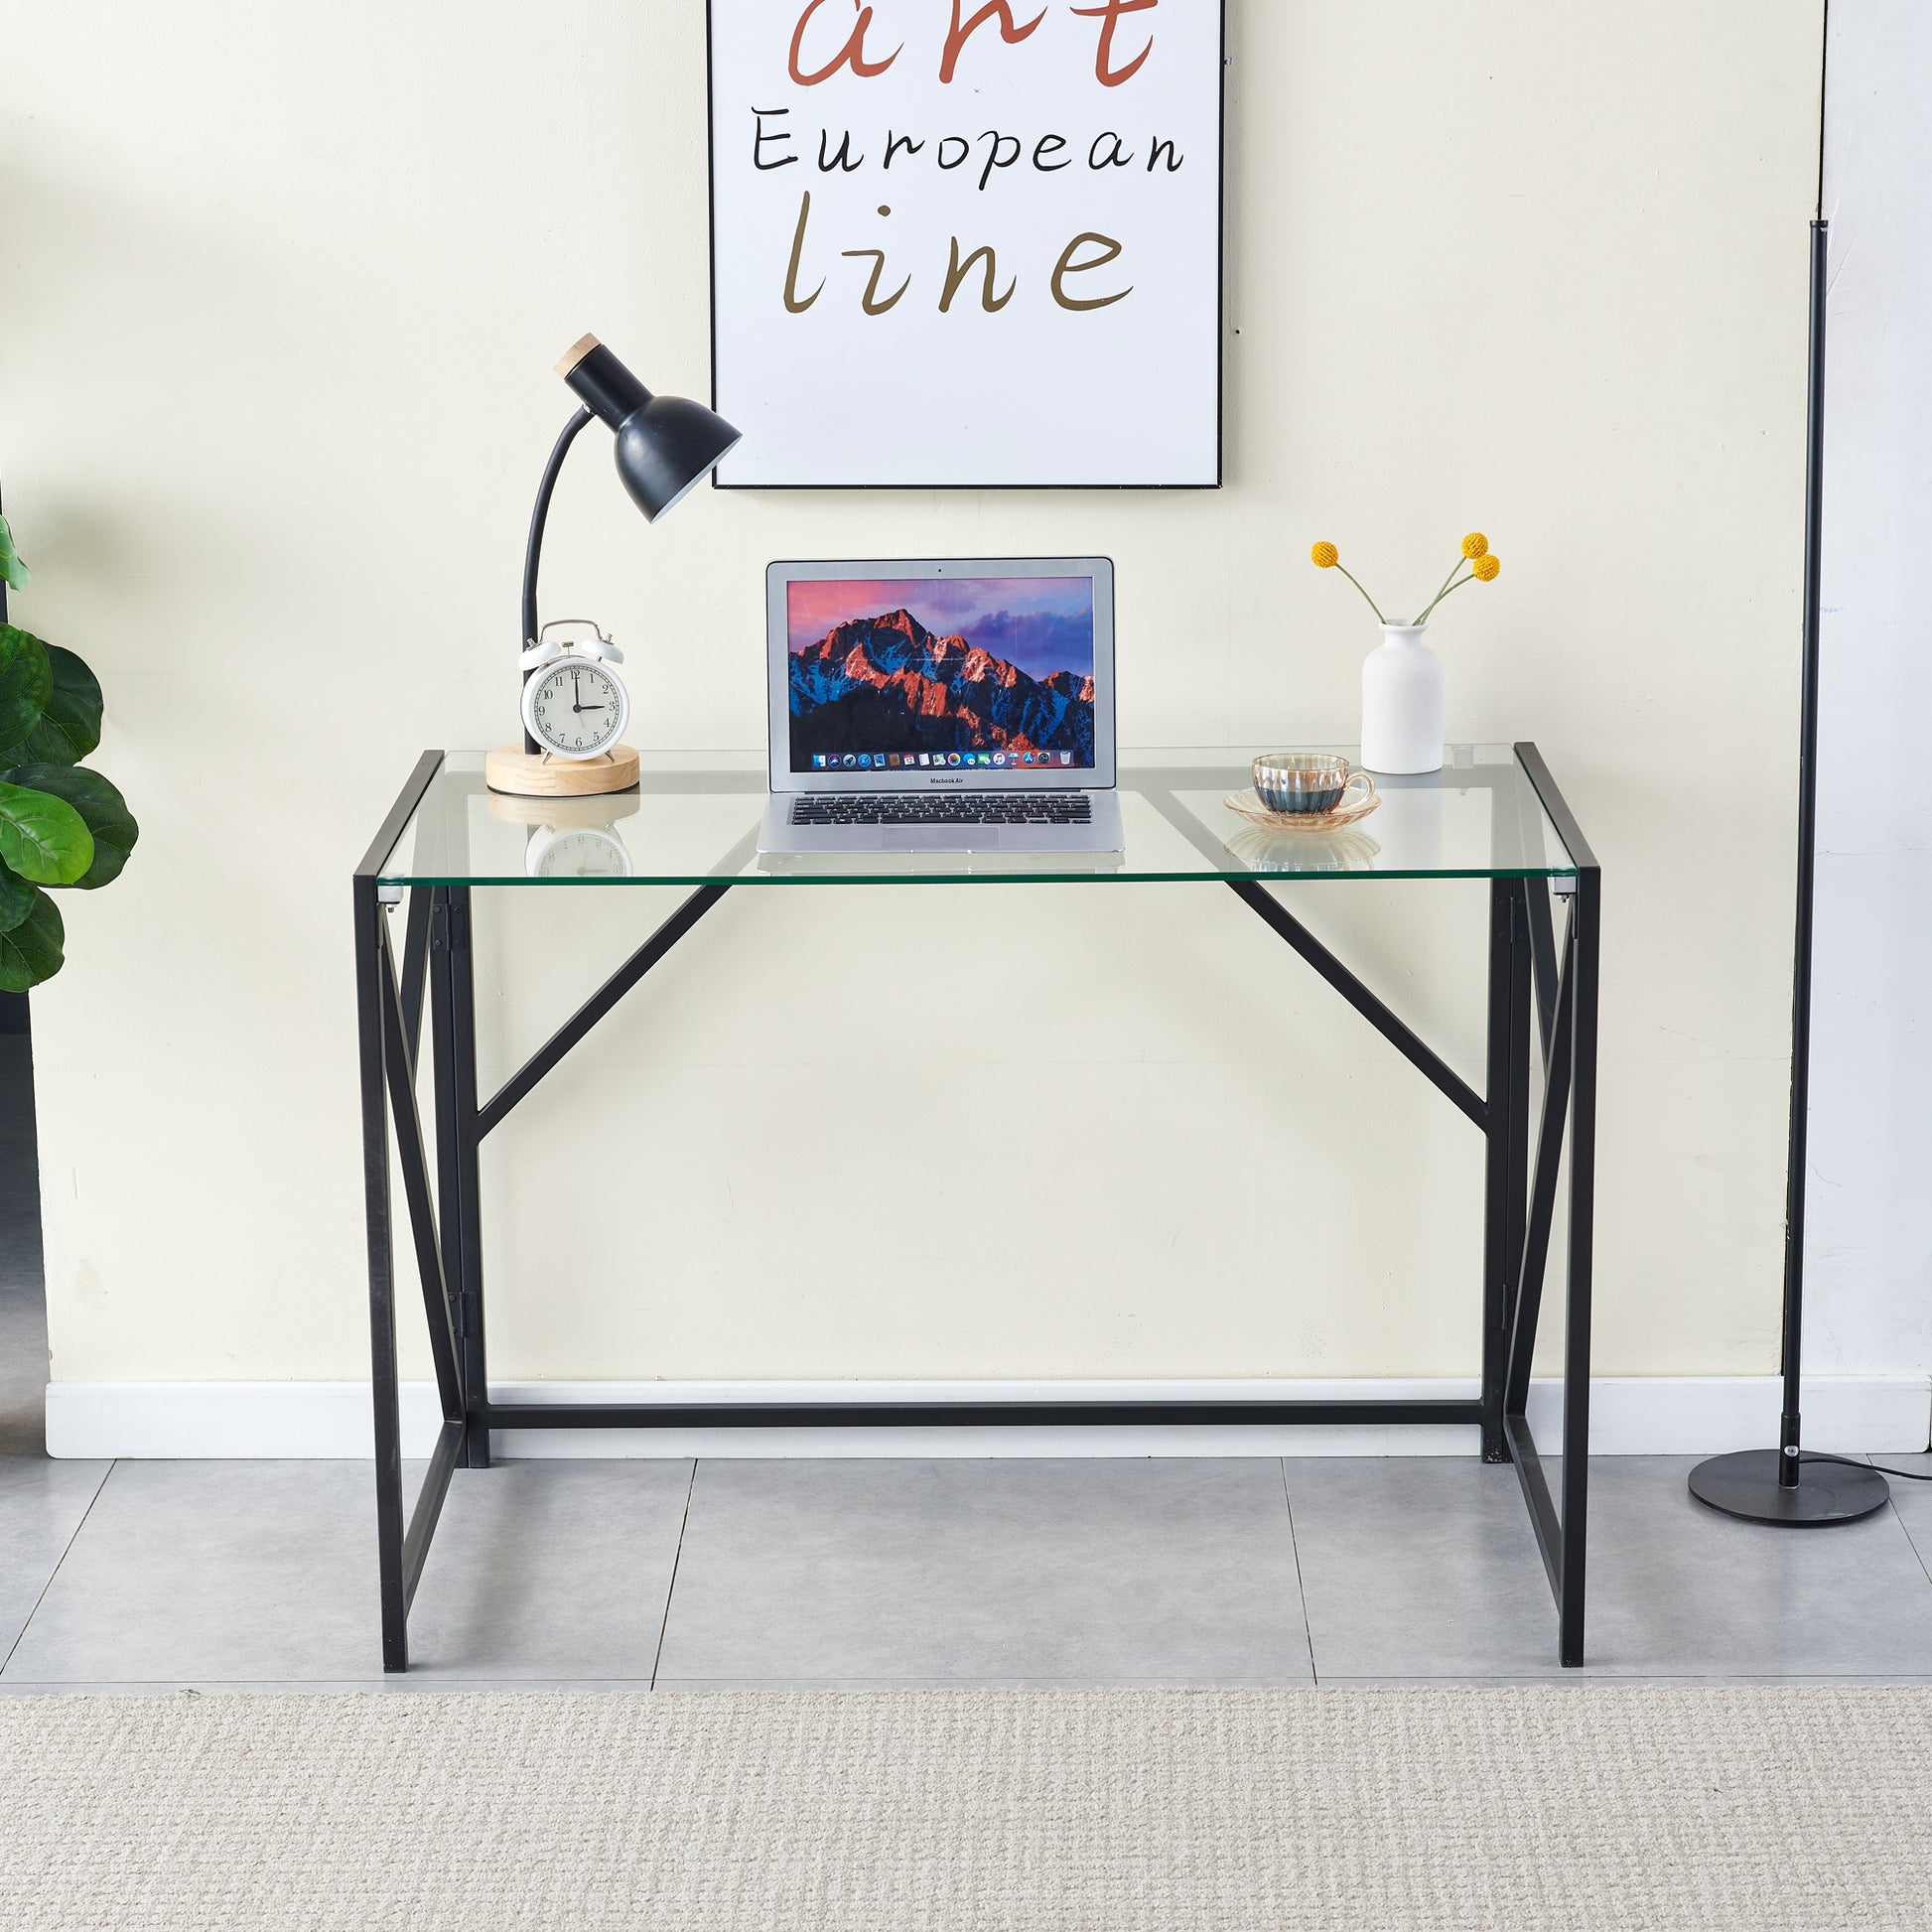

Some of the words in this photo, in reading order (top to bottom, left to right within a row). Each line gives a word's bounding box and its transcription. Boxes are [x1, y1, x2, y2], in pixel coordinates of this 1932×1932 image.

[787, 0, 1159, 88] art
[751, 105, 1184, 192] European
[782, 190, 1135, 317] line
[571, 670, 581, 679] 12
[555, 677, 564, 686] 11
[603, 685, 609, 694] 2
[544, 690, 554, 699] 10
[610, 701, 615, 711] 3
[539, 707, 545, 716] 9
[545, 723, 551, 732] 8
[559, 734, 565, 743] 7
[594, 732, 600, 742] 5
[576, 738, 583, 747] 6
